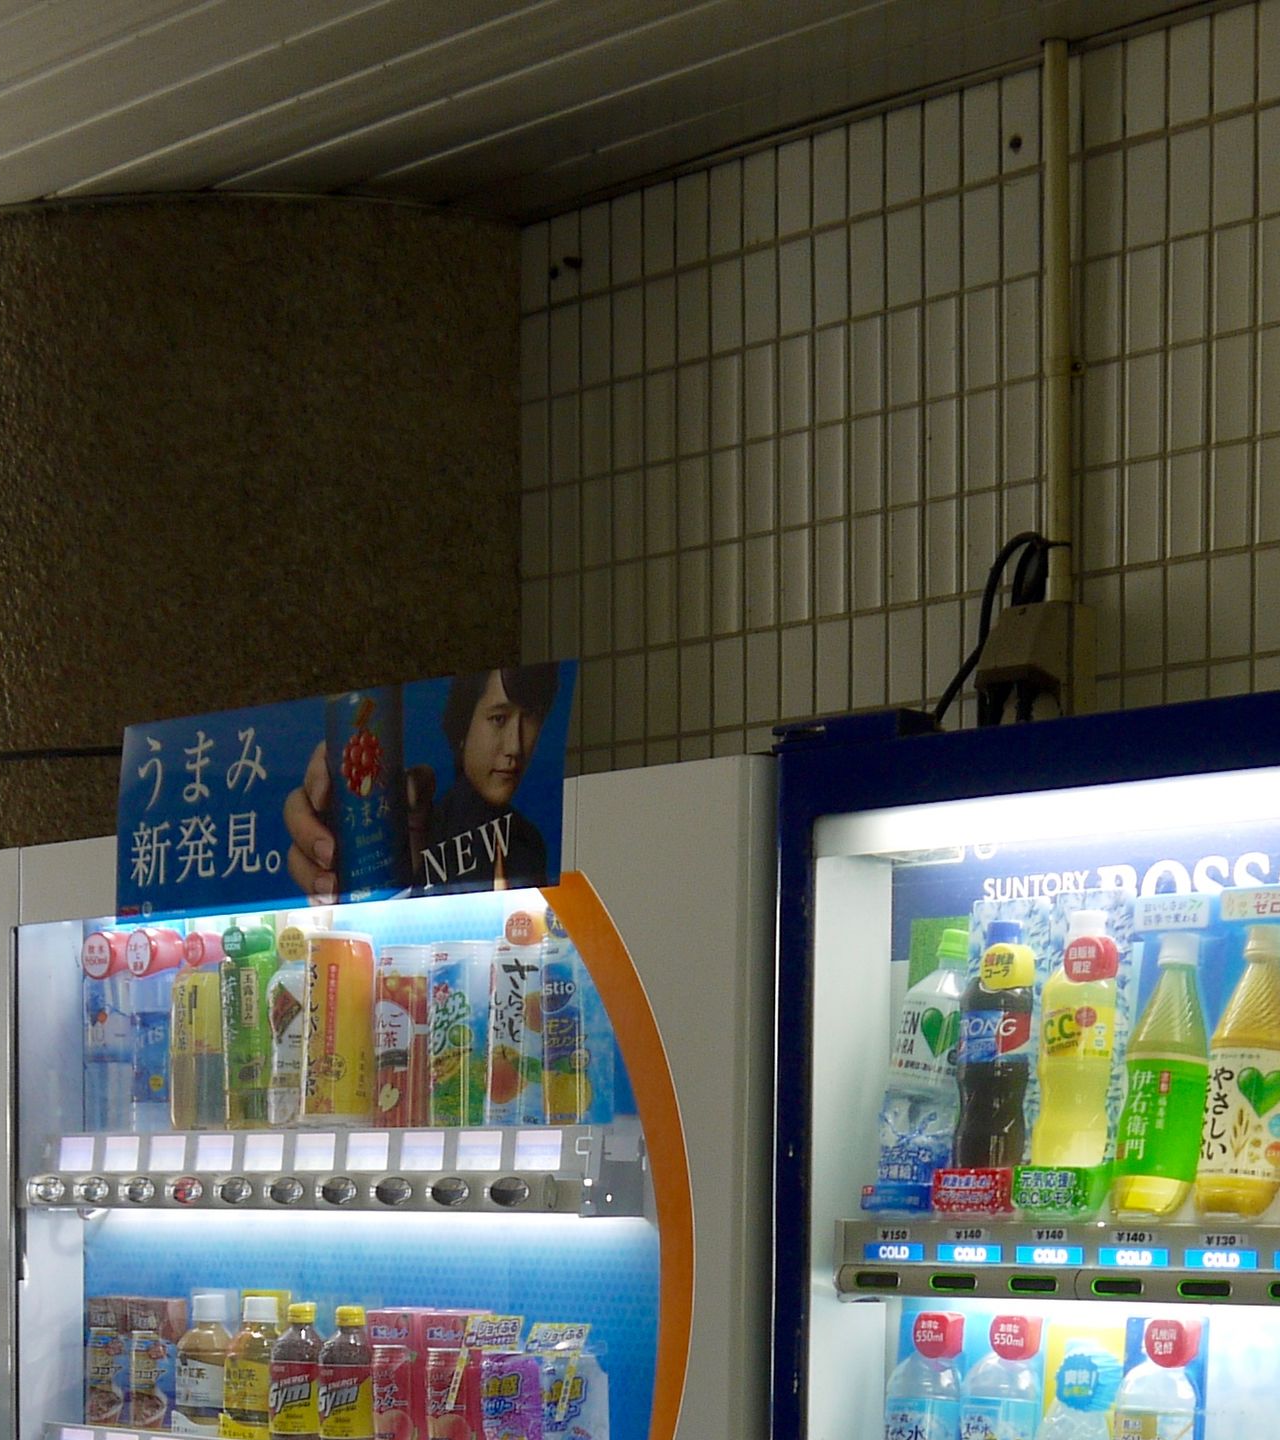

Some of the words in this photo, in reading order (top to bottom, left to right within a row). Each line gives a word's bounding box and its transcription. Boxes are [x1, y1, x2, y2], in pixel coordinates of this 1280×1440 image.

[138, 726, 268, 811] うまみ
[129, 810, 281, 887] 新発見。
[419, 812, 513, 890] NEW
[982, 868, 1090, 902] SUNTORY
[1097, 851, 1271, 897] BOSS
[984, 965, 1010, 979] コーラ
[1125, 1068, 1155, 1160] 伊右衛門
[1207, 1066, 1235, 1161] やさしい
[1021, 1171, 1076, 1189] 元気応援!
[881, 1230, 908, 1240] ¥150
[955, 1229, 982, 1240] ¥140
[1036, 1230, 1064, 1240] ¥140
[1115, 1230, 1147, 1244] ¥140
[1205, 1233, 1237, 1246] ¥130
[878, 1245, 910, 1259] COLD
[953, 1246, 988, 1262] COLD
[1032, 1247, 1069, 1264] COLD
[1114, 1249, 1153, 1266] COLD
[1201, 1251, 1240, 1268] COLD
[915, 1329, 944, 1343] 550ml
[993, 1332, 1025, 1348] 550ml
